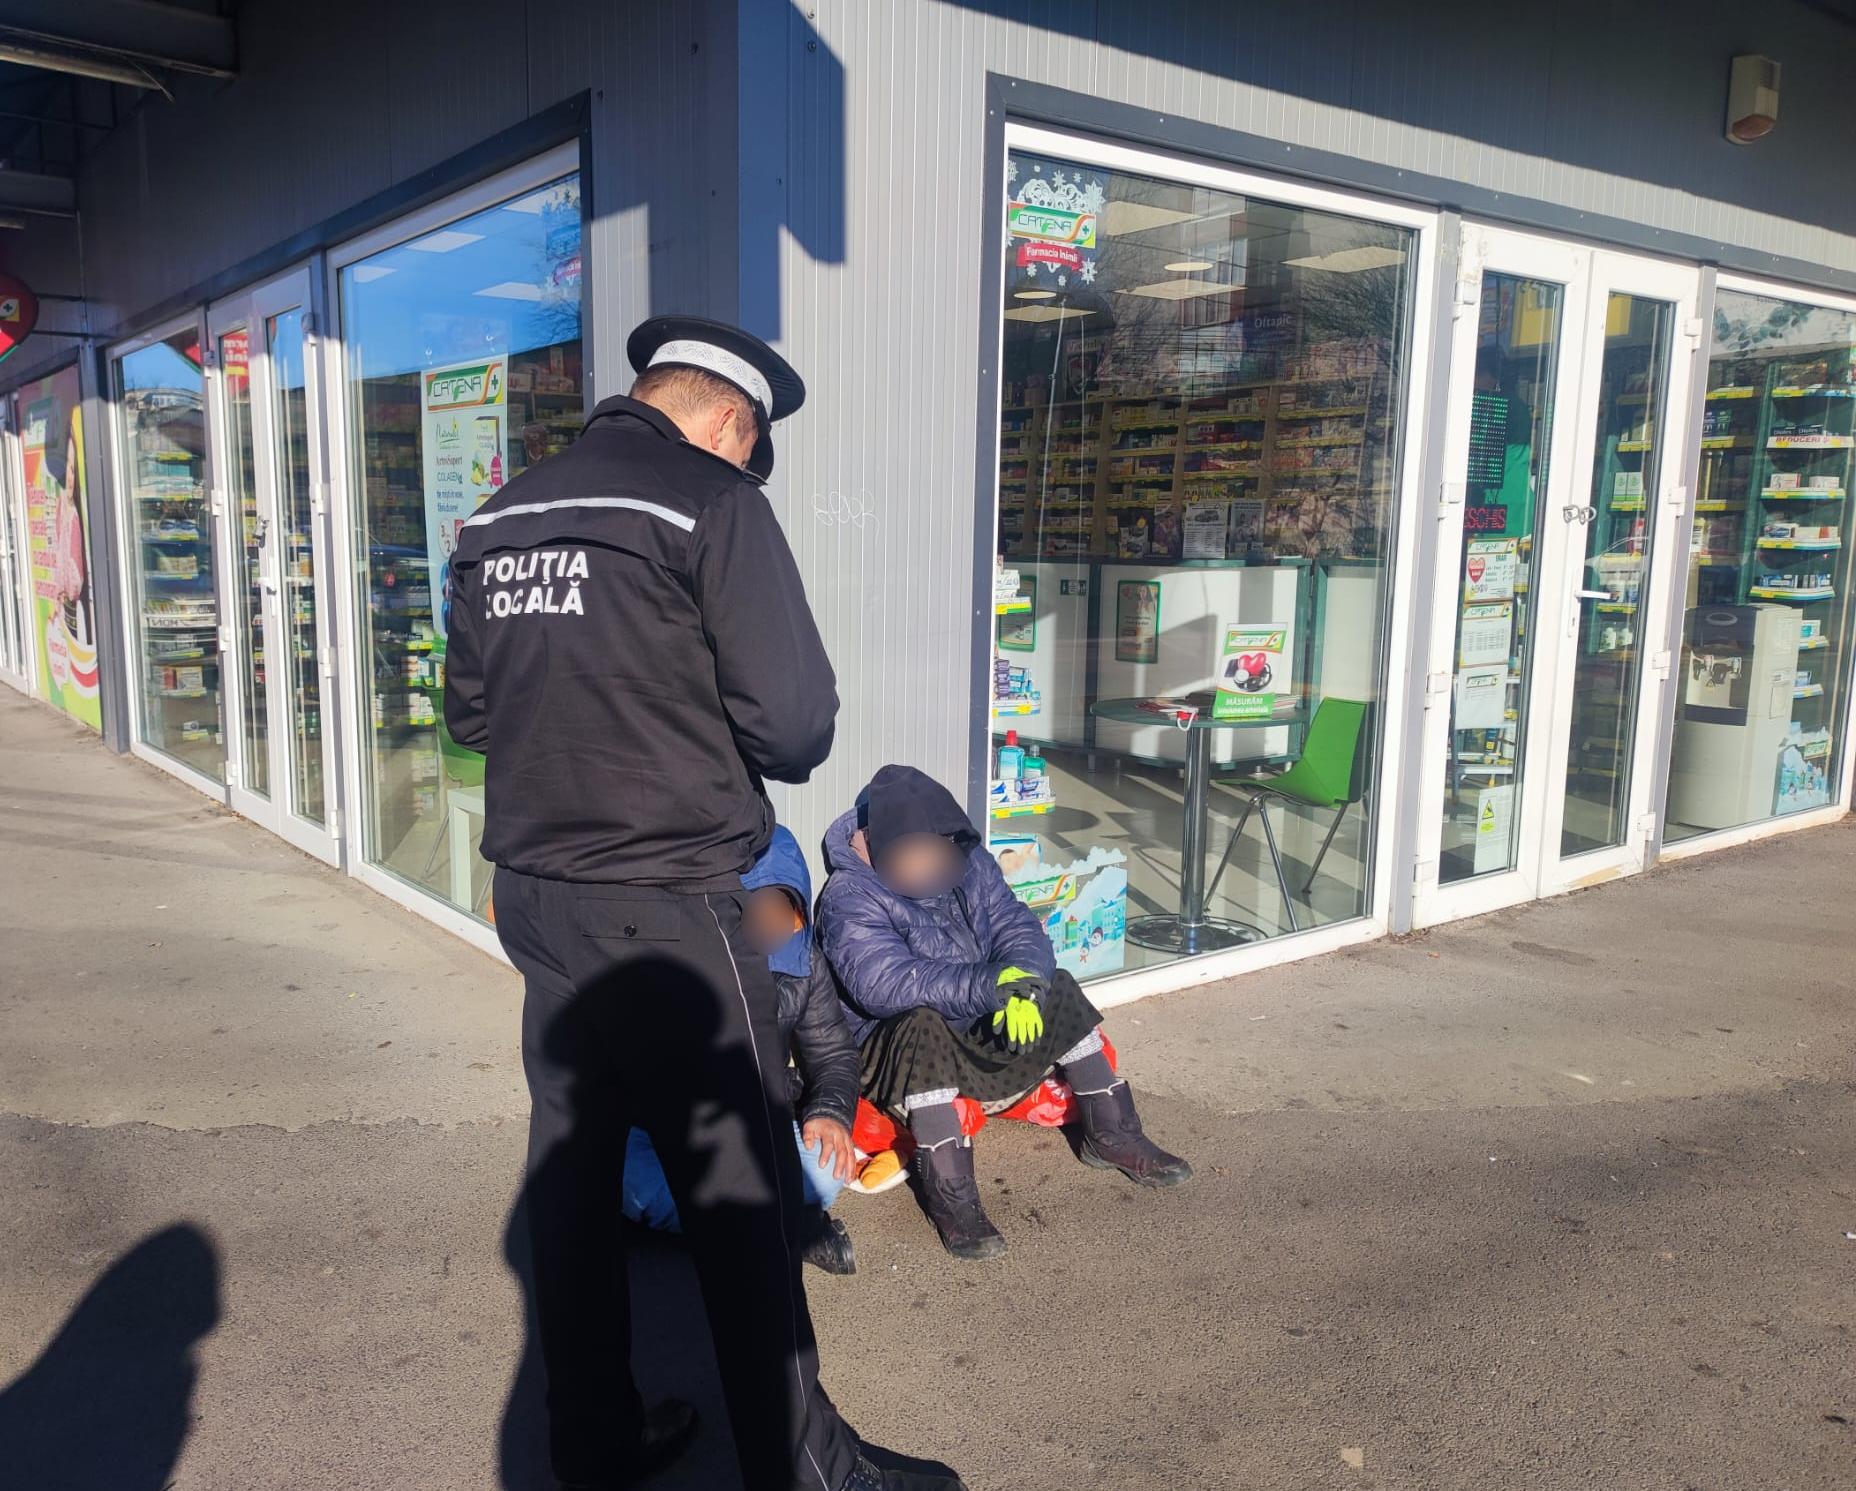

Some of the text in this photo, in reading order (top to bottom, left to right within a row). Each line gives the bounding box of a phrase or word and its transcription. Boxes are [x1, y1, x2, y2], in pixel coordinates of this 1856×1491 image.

[1018, 213, 1072, 232] CATENA
[1026, 246, 1059, 258] Farmacia
[433, 376, 481, 399] CATENA
[1014, 884, 1056, 902] ATENA
